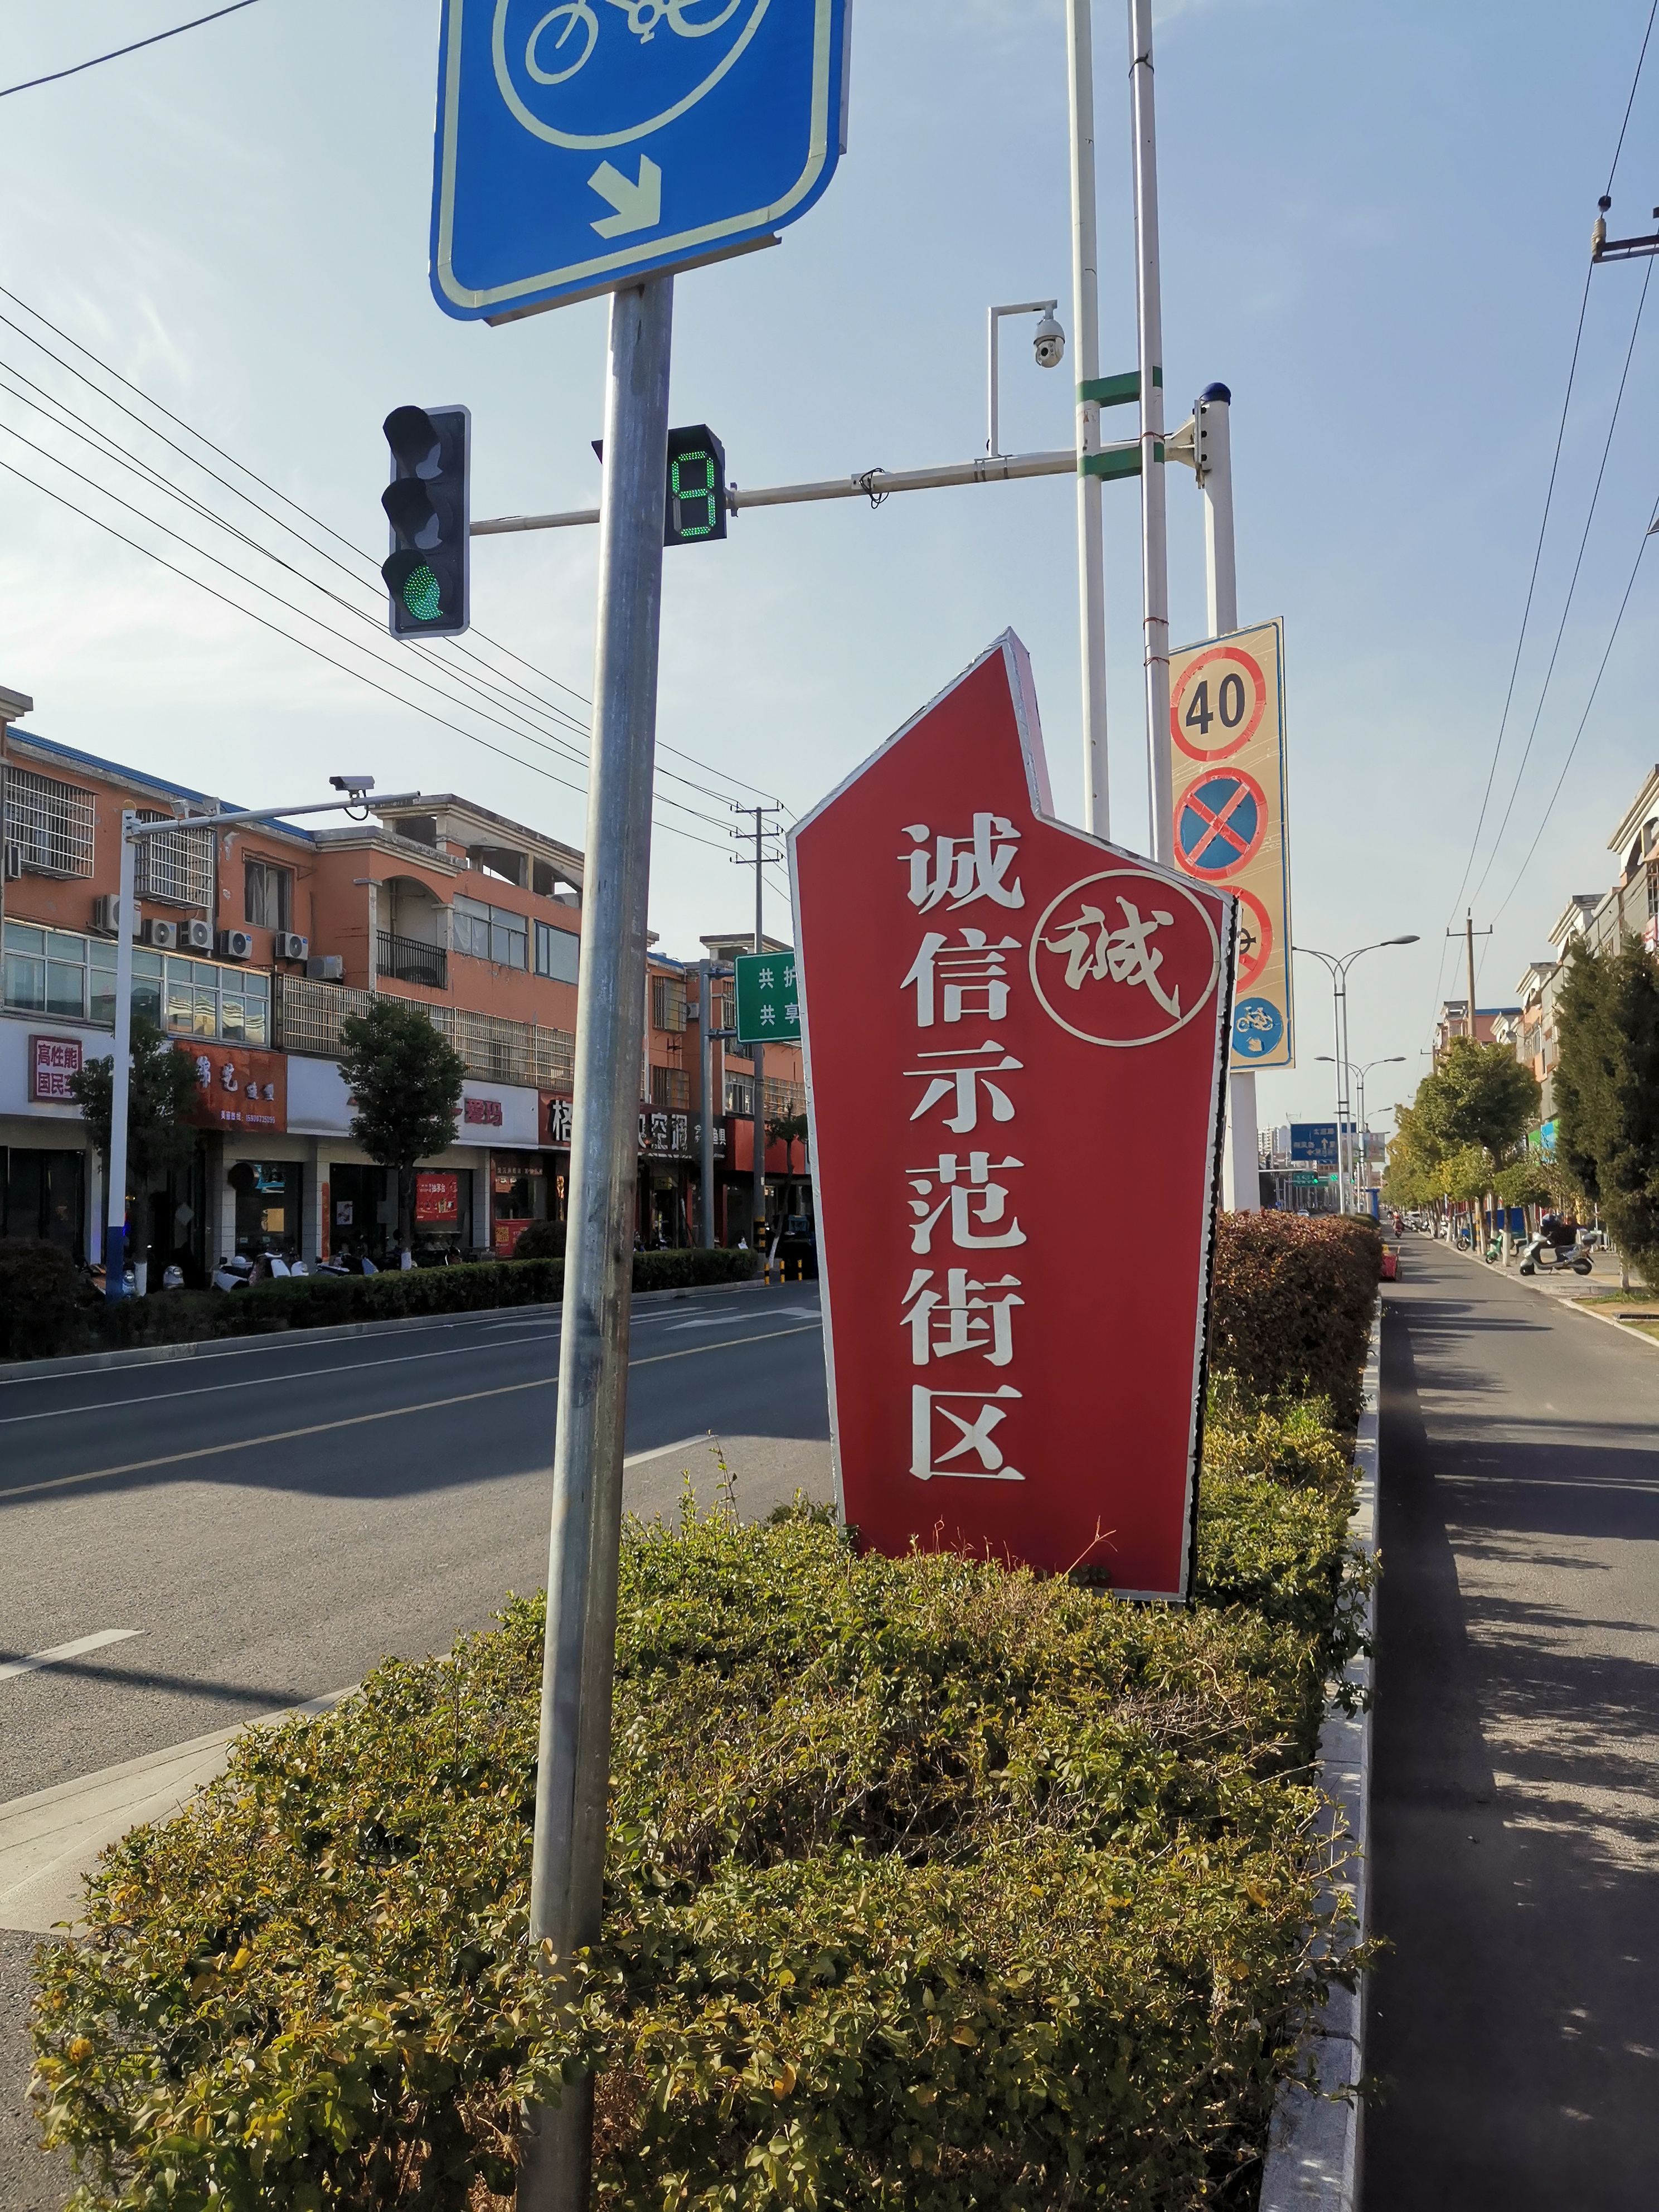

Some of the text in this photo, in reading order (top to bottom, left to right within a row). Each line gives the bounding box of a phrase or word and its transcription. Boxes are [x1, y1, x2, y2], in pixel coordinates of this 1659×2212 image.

[671, 450, 716, 537] 9
[1185, 673, 1245, 735] 40
[760, 1002, 800, 1026] 共享
[38, 1044, 77, 1069] 高性能
[465, 1098, 502, 1126] 爱玛
[551, 1099, 573, 1141] 格
[897, 812, 1027, 1481] 诚信示范街区
